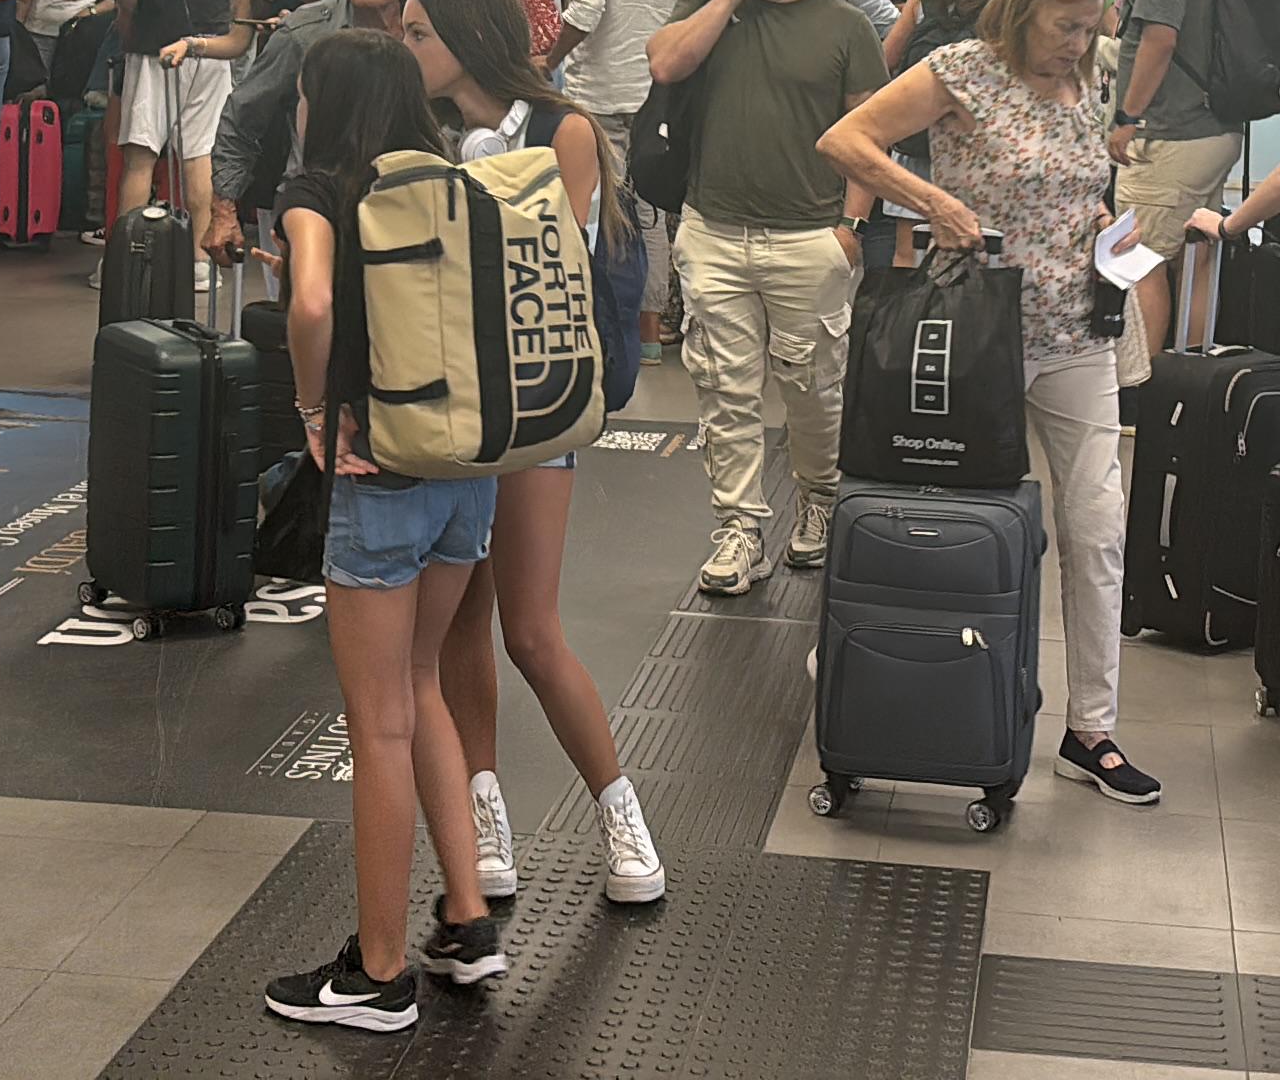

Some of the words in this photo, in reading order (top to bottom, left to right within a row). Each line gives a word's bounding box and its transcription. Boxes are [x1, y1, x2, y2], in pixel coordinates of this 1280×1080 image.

[506, 235, 547, 357] FACE
[521, 197, 575, 355] NORTH
[567, 262, 594, 352] THE
[892, 434, 925, 451] Shop
[925, 437, 966, 453] Online
